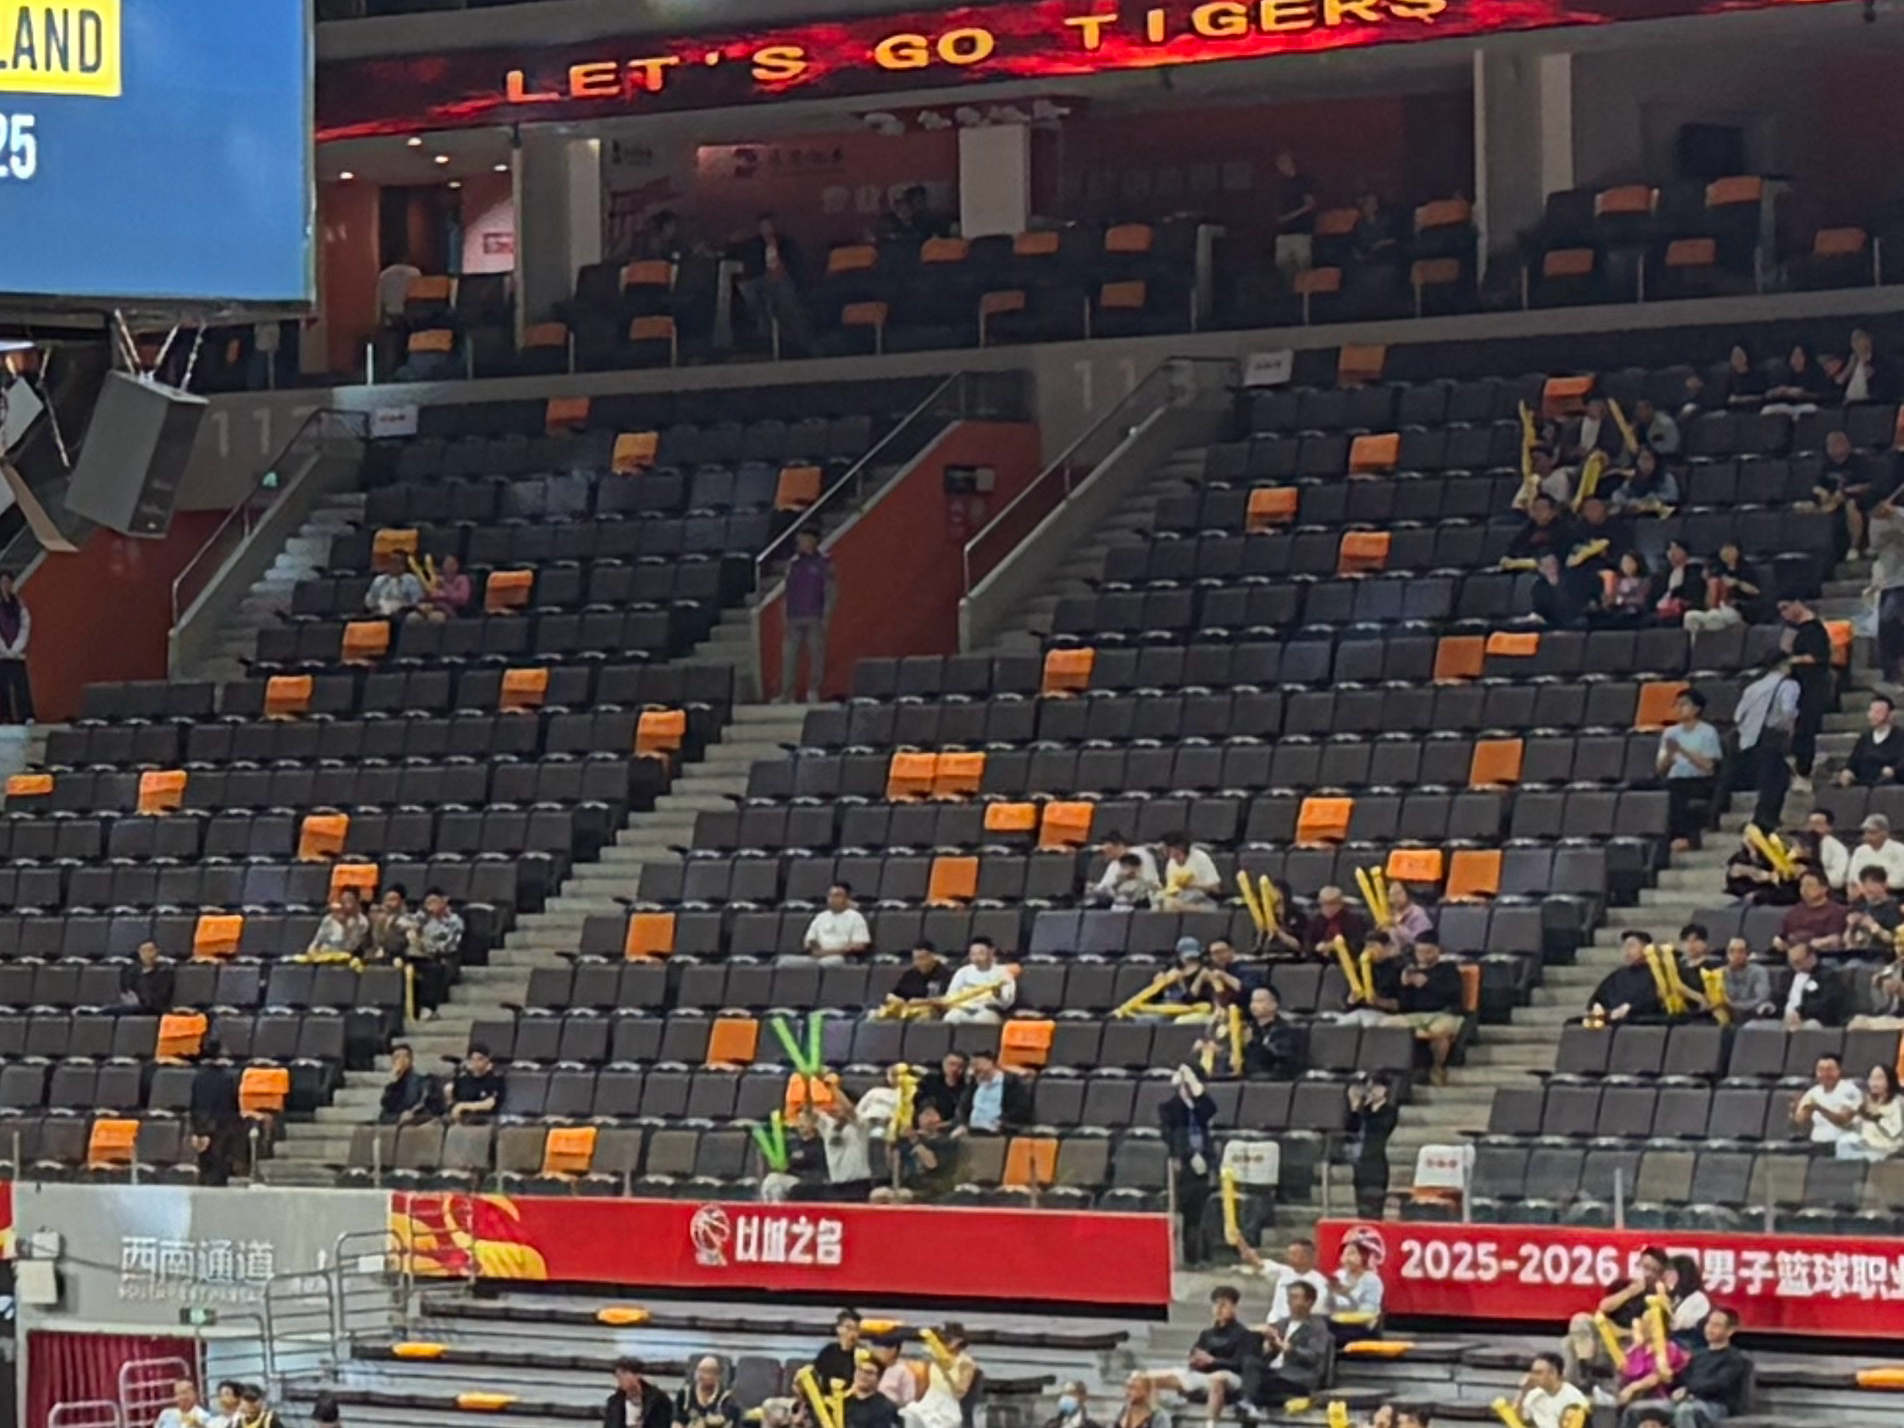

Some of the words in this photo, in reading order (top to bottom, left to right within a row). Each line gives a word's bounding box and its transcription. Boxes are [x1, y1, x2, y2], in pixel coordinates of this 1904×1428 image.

[505, 43, 809, 105] LET'S
[873, 27, 994, 71] GO
[120, 1236, 275, 1285] 西南通道
